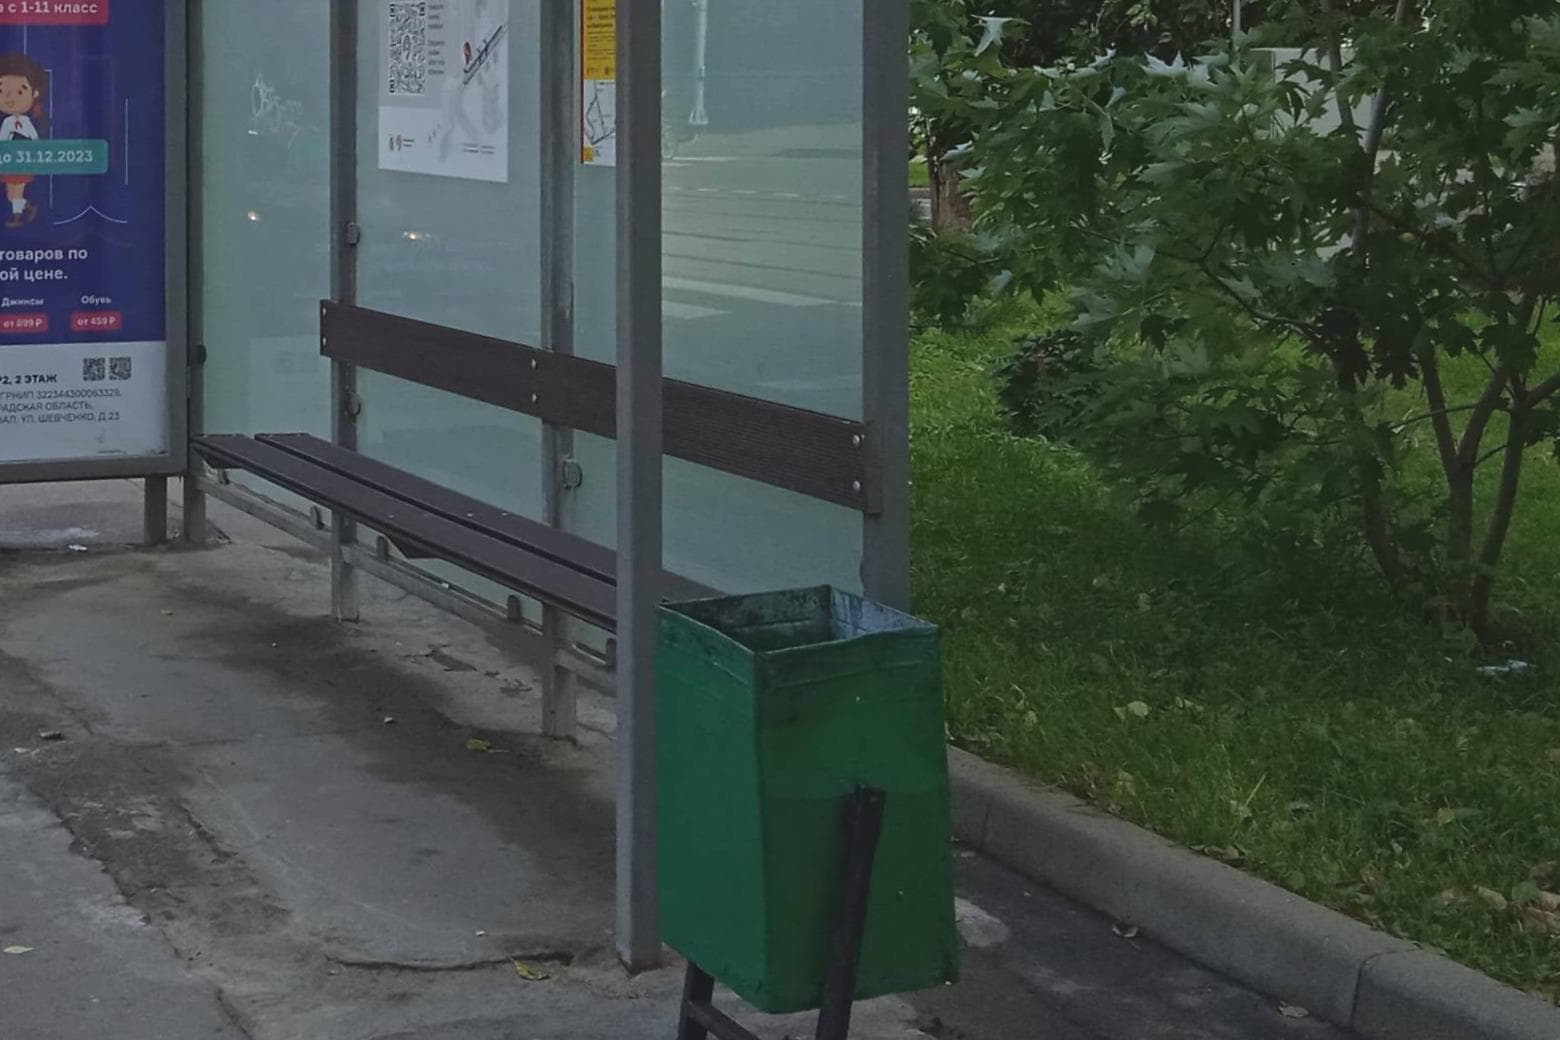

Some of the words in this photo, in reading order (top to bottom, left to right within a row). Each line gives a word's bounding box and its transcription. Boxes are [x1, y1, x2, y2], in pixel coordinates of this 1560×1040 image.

[8, 3, 16, 13] с
[21, 1, 50, 13] 1-11
[54, 3, 98, 13] класс
[17, 150, 93, 163] 31.12.2023
[68, 250, 88, 260] по
[23, 269, 68, 282] цене.
[1, 297, 44, 307] Джинсы
[81, 295, 111, 305] Обувь
[77, 318, 88, 326] от
[14, 375, 22, 384] 2
[24, 374, 57, 384] ЭТАЖ
